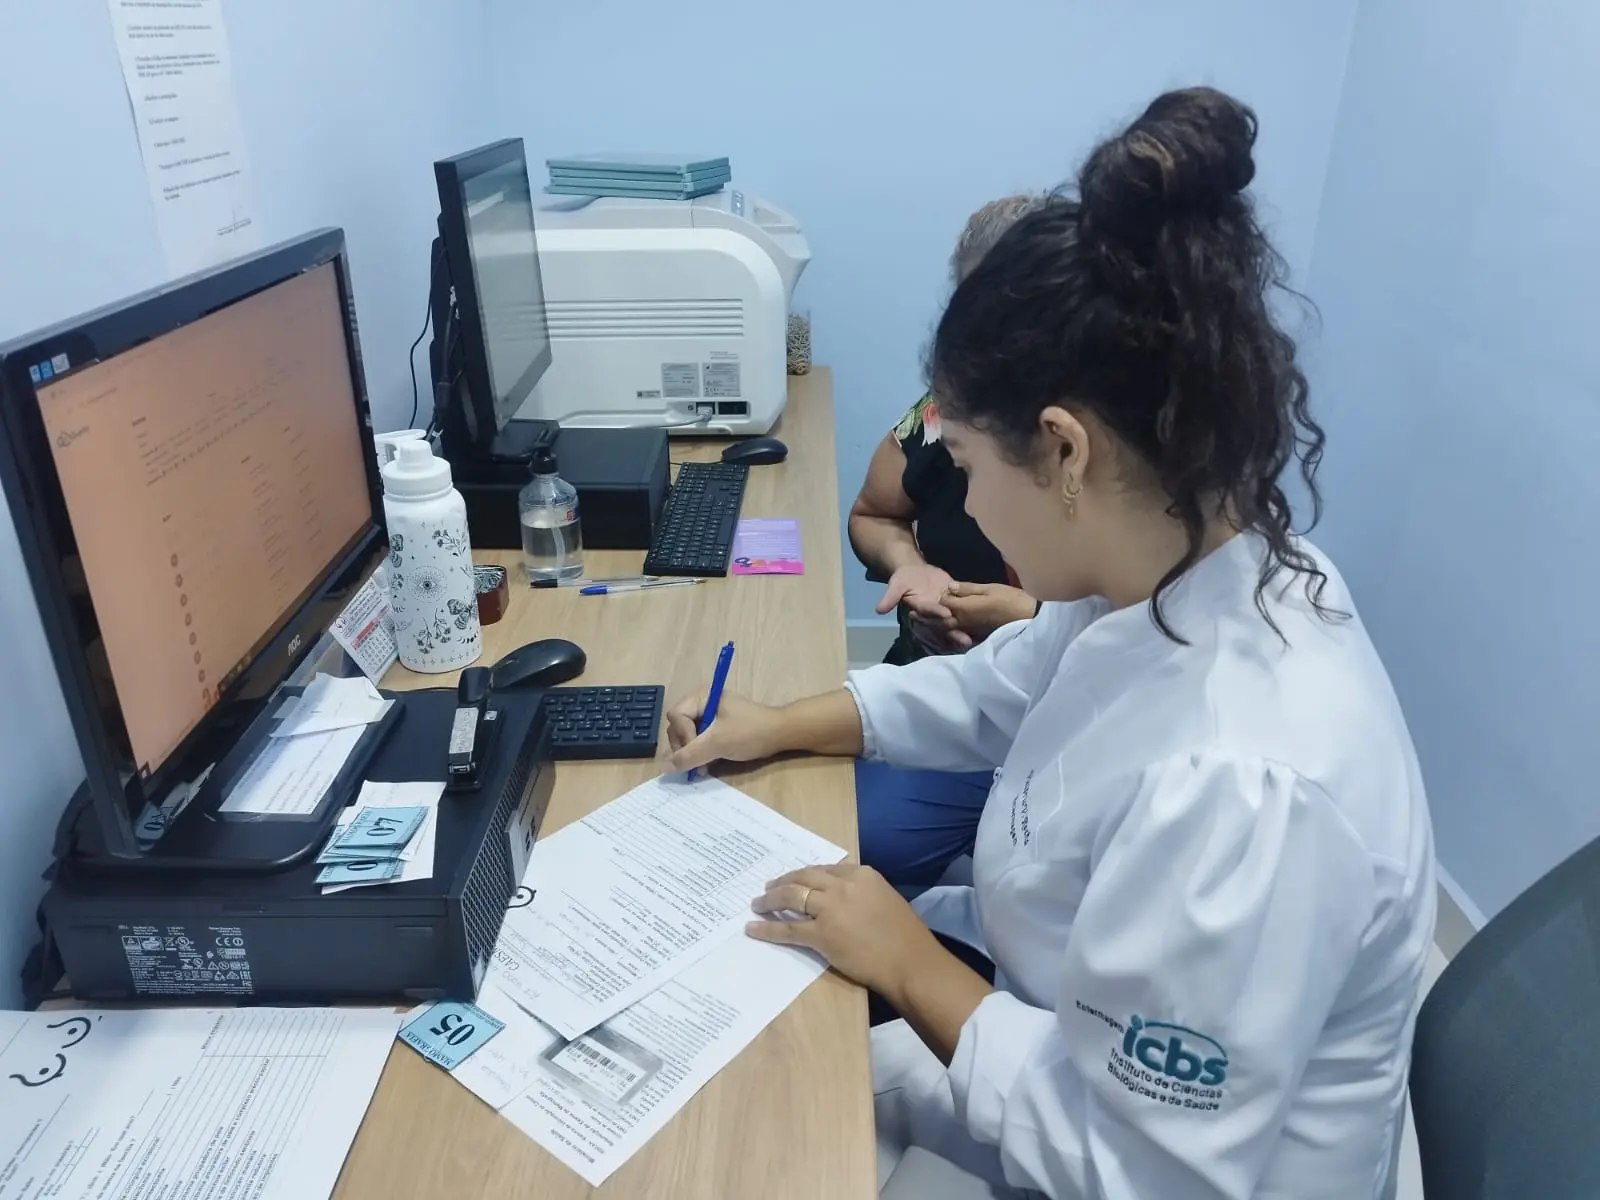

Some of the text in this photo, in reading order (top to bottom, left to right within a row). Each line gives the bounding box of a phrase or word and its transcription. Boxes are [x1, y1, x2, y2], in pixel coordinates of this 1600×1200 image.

[287, 634, 301, 657] AOC
[405, 1031, 454, 1066] MAMOGRAFIA
[429, 1013, 475, 1046] 05
[1123, 1014, 1229, 1086] icbs
[1107, 1062, 1220, 1111] Biológicas e da Saúde
[1110, 1047, 1223, 1099] Instituto de Ciências
